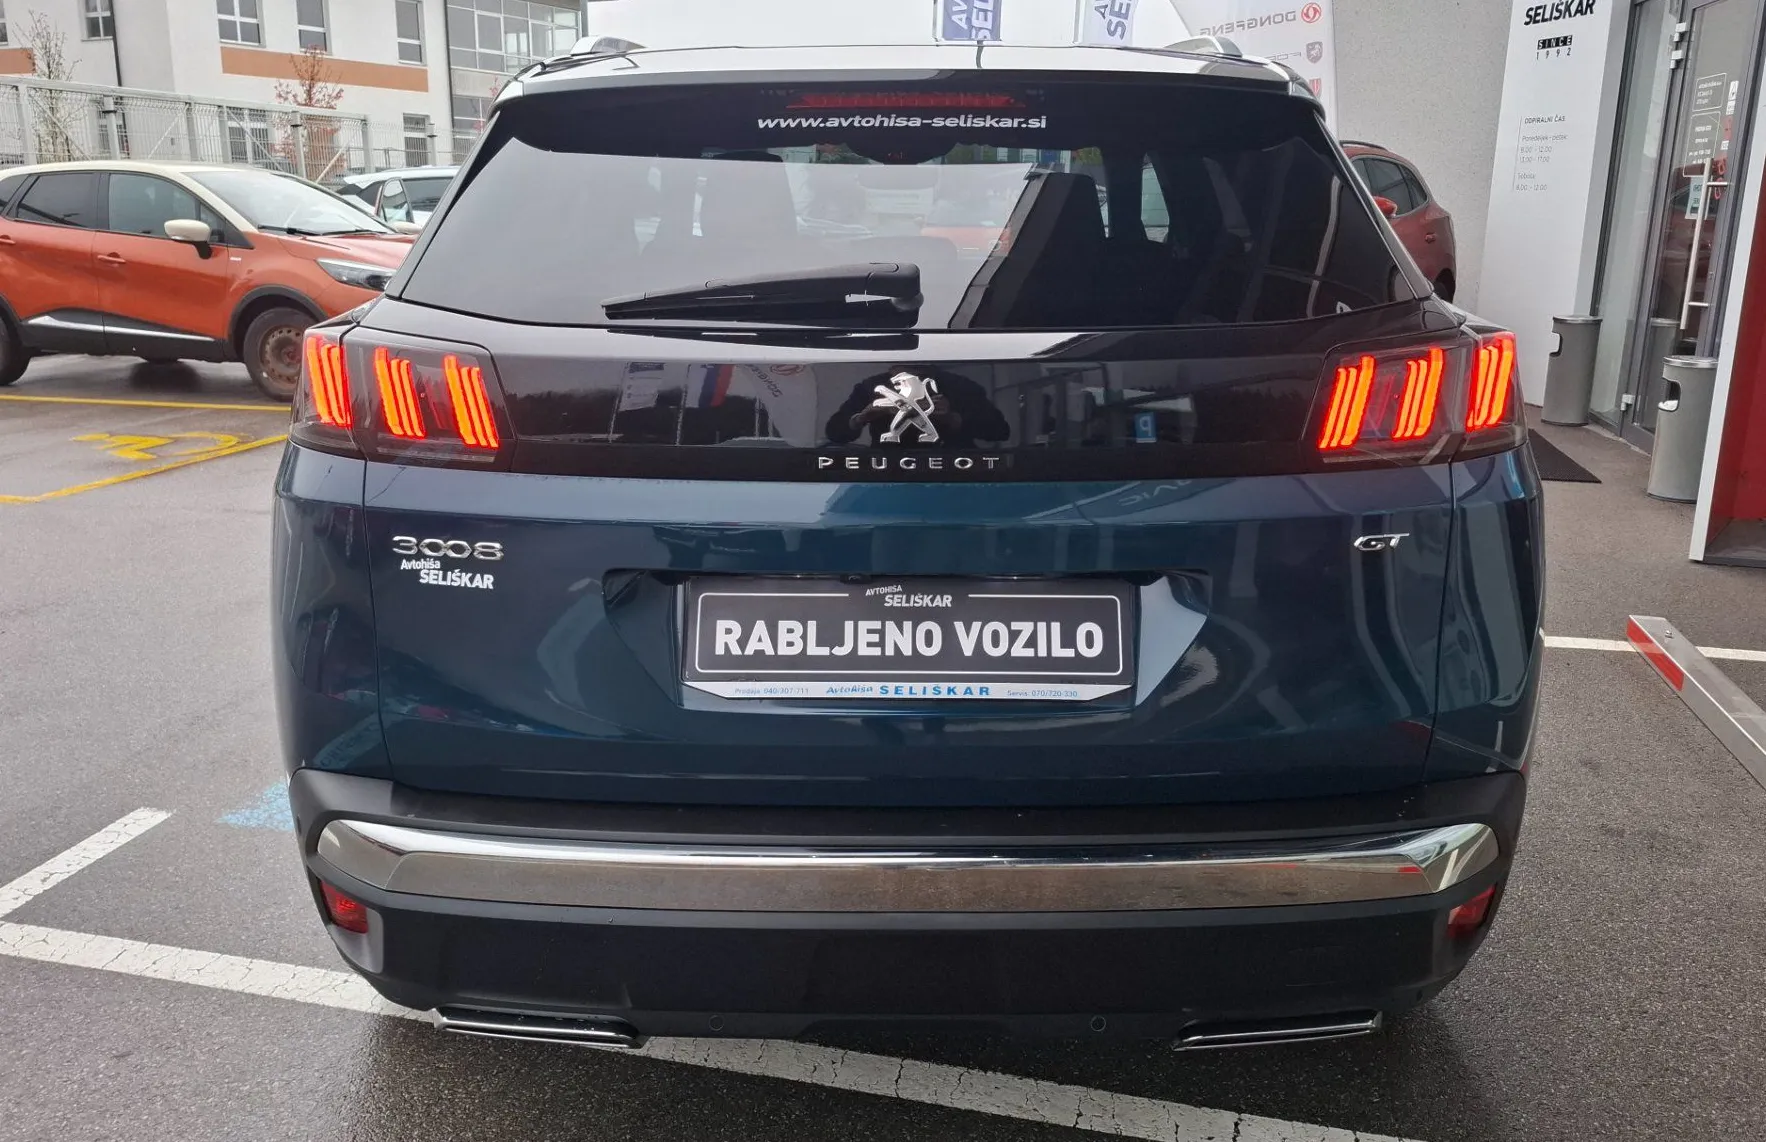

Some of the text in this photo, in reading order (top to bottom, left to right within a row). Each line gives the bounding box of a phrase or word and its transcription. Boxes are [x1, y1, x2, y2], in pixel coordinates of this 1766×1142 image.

[1537, 35, 1573, 50] SINCE
[757, 114, 1047, 129] www.avtohisa-seliskar.si
[818, 457, 999, 469] PEUGEOT
[392, 535, 504, 560] 3008
[1353, 532, 1410, 551] GT
[884, 593, 953, 607] SELIŠKAR
[715, 620, 1103, 658] RABLJENO VOZILO
[879, 684, 991, 696] SELIŠKAR
